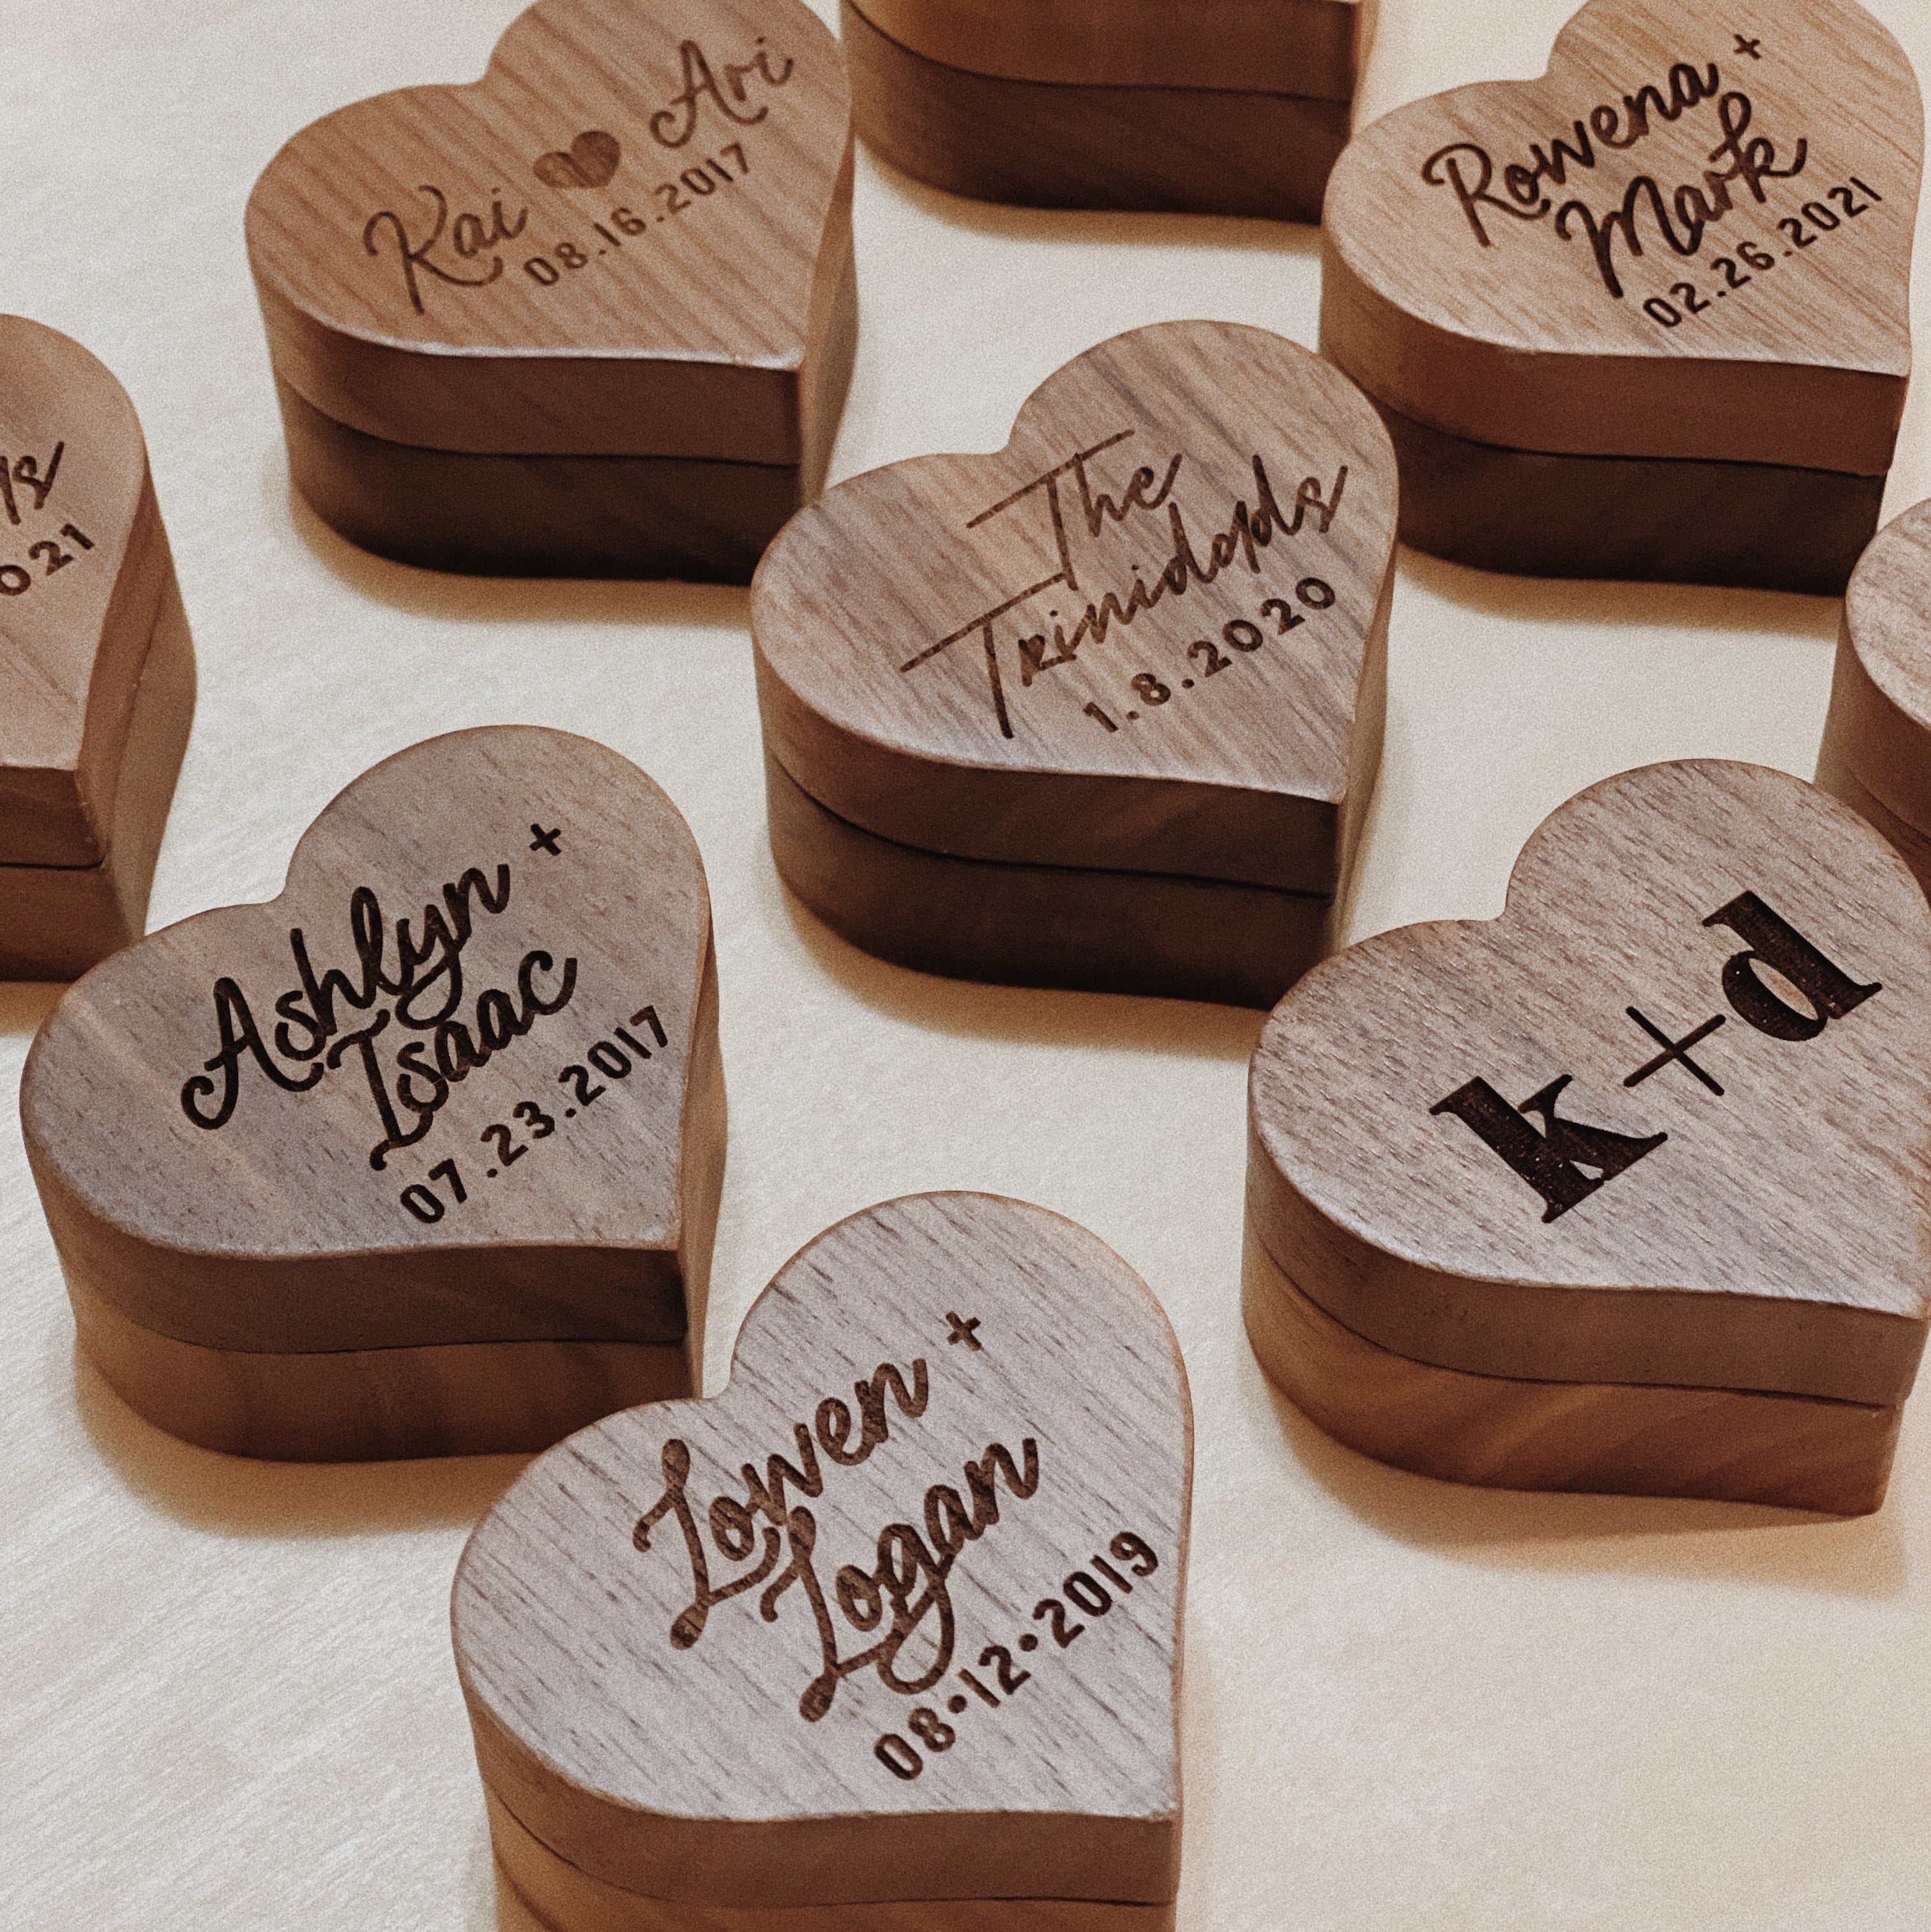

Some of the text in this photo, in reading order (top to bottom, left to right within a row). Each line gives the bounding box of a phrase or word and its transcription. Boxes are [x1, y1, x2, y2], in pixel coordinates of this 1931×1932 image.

[361, 36, 794, 315] Kai Ari
[523, 142, 752, 287] 08.16.2017
[1421, 62, 1720, 248] Rowena
[1554, 91, 1808, 299] Mark
[1643, 177, 1882, 329] 02.26.2021
[900, 454, 1349, 740] Trinidads
[966, 428, 1183, 591] The
[1082, 577, 1337, 734] 1.8.2020
[180, 864, 510, 1131] Ashlyn
[326, 949, 578, 1172] Isaac
[399, 1005, 669, 1225] 07.23.2017
[632, 1357, 928, 1650] Lowen
[760, 1437, 1040, 1723] Logan
